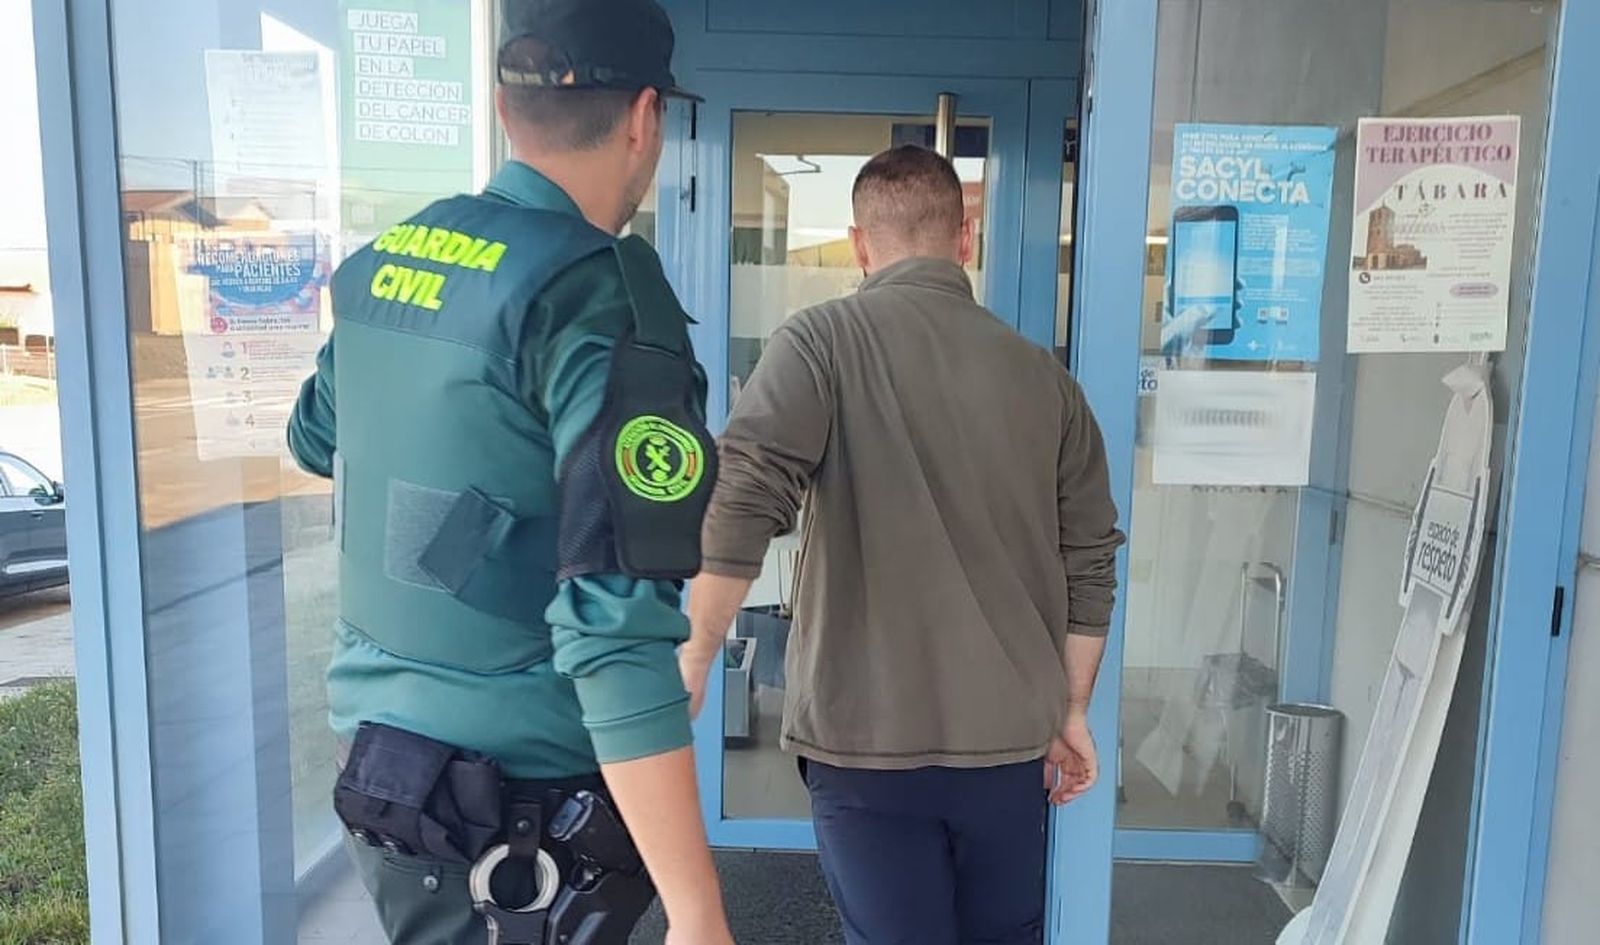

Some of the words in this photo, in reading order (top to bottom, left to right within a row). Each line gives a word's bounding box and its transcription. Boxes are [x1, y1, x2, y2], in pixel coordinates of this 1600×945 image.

[358, 12, 415, 30] JUEGA
[358, 35, 382, 51] TU
[387, 36, 442, 55] PAPEL
[358, 57, 383, 74] EN
[387, 58, 410, 75] LA
[358, 101, 393, 118] DEL
[358, 124, 384, 140] DE
[386, 125, 450, 144] COLON
[1382, 123, 1493, 143] EJERCICIO
[1365, 143, 1512, 164] TERAPÉUTICO
[1179, 155, 1270, 181] SACYL
[1175, 178, 1311, 206] CONECTA
[1394, 180, 1509, 201] TÁBARA
[373, 224, 507, 272] GUARDIA
[234, 261, 301, 278] PACIENTES
[370, 262, 447, 311] CIVIL
[241, 342, 248, 354] 1
[240, 367, 250, 381] 2
[1139, 377, 1158, 391] to
[243, 390, 252, 403] 3
[245, 413, 255, 427] 4
[1417, 541, 1457, 583] respeto
